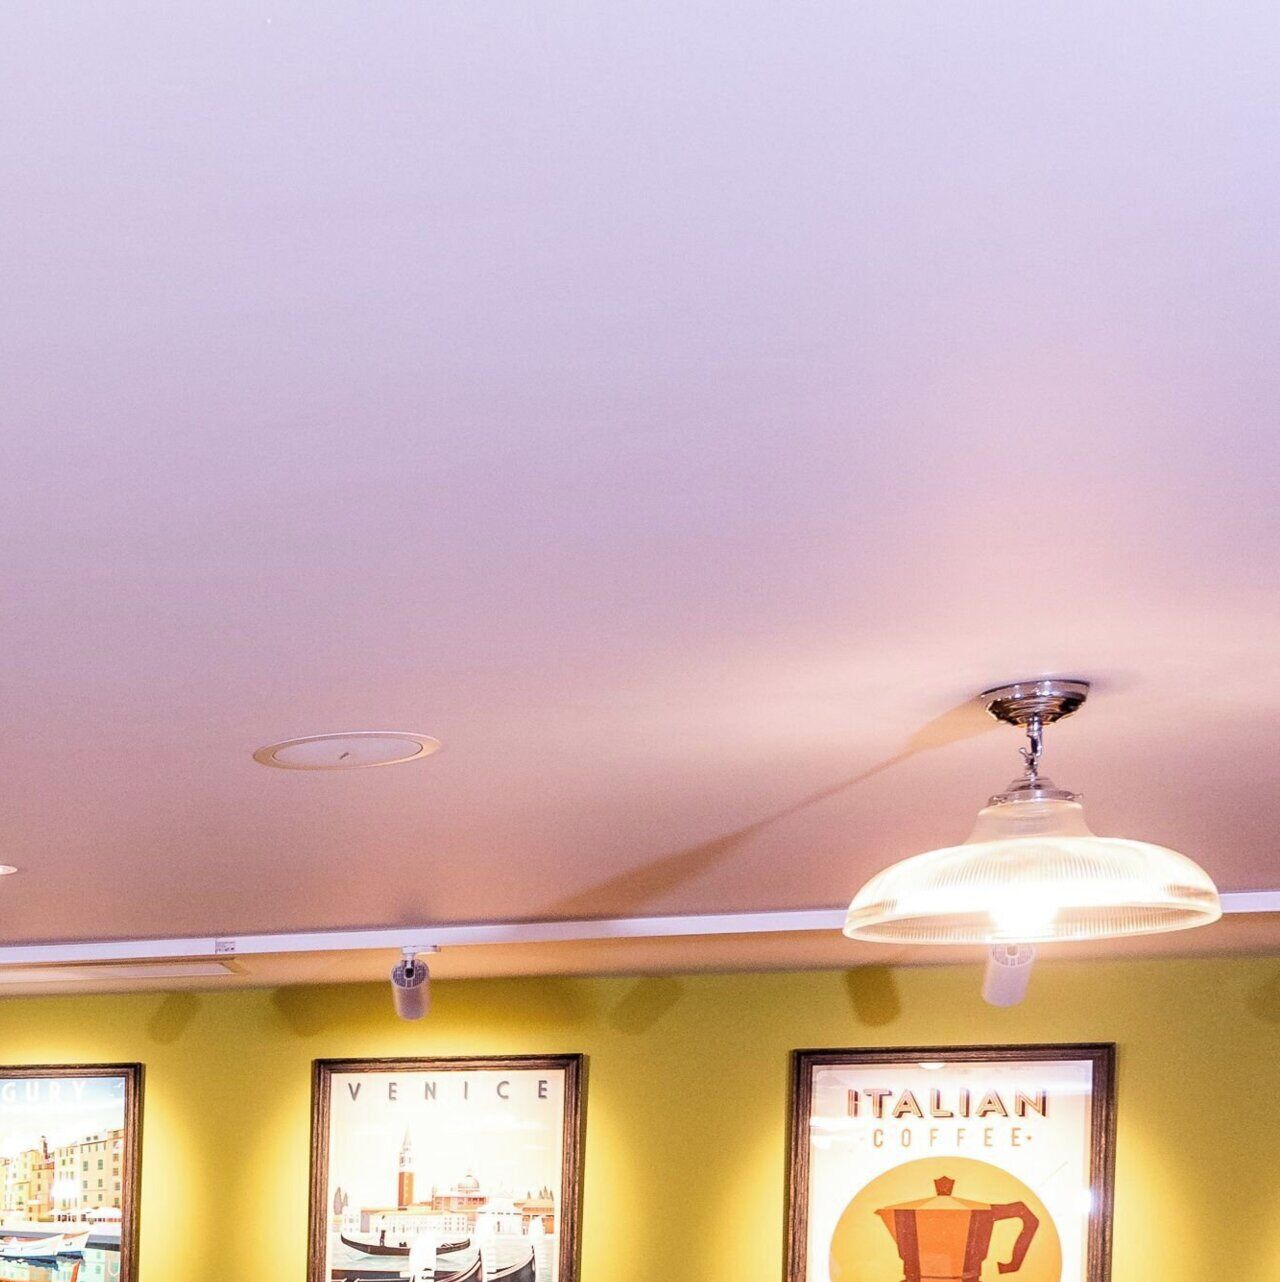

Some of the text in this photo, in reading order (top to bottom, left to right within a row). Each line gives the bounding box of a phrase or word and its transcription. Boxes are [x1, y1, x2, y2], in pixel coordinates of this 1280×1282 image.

[348, 1079, 548, 1101] VENICE
[848, 1088, 1048, 1118] ITALIAN
[872, 1127, 1022, 1148] COFFEE
